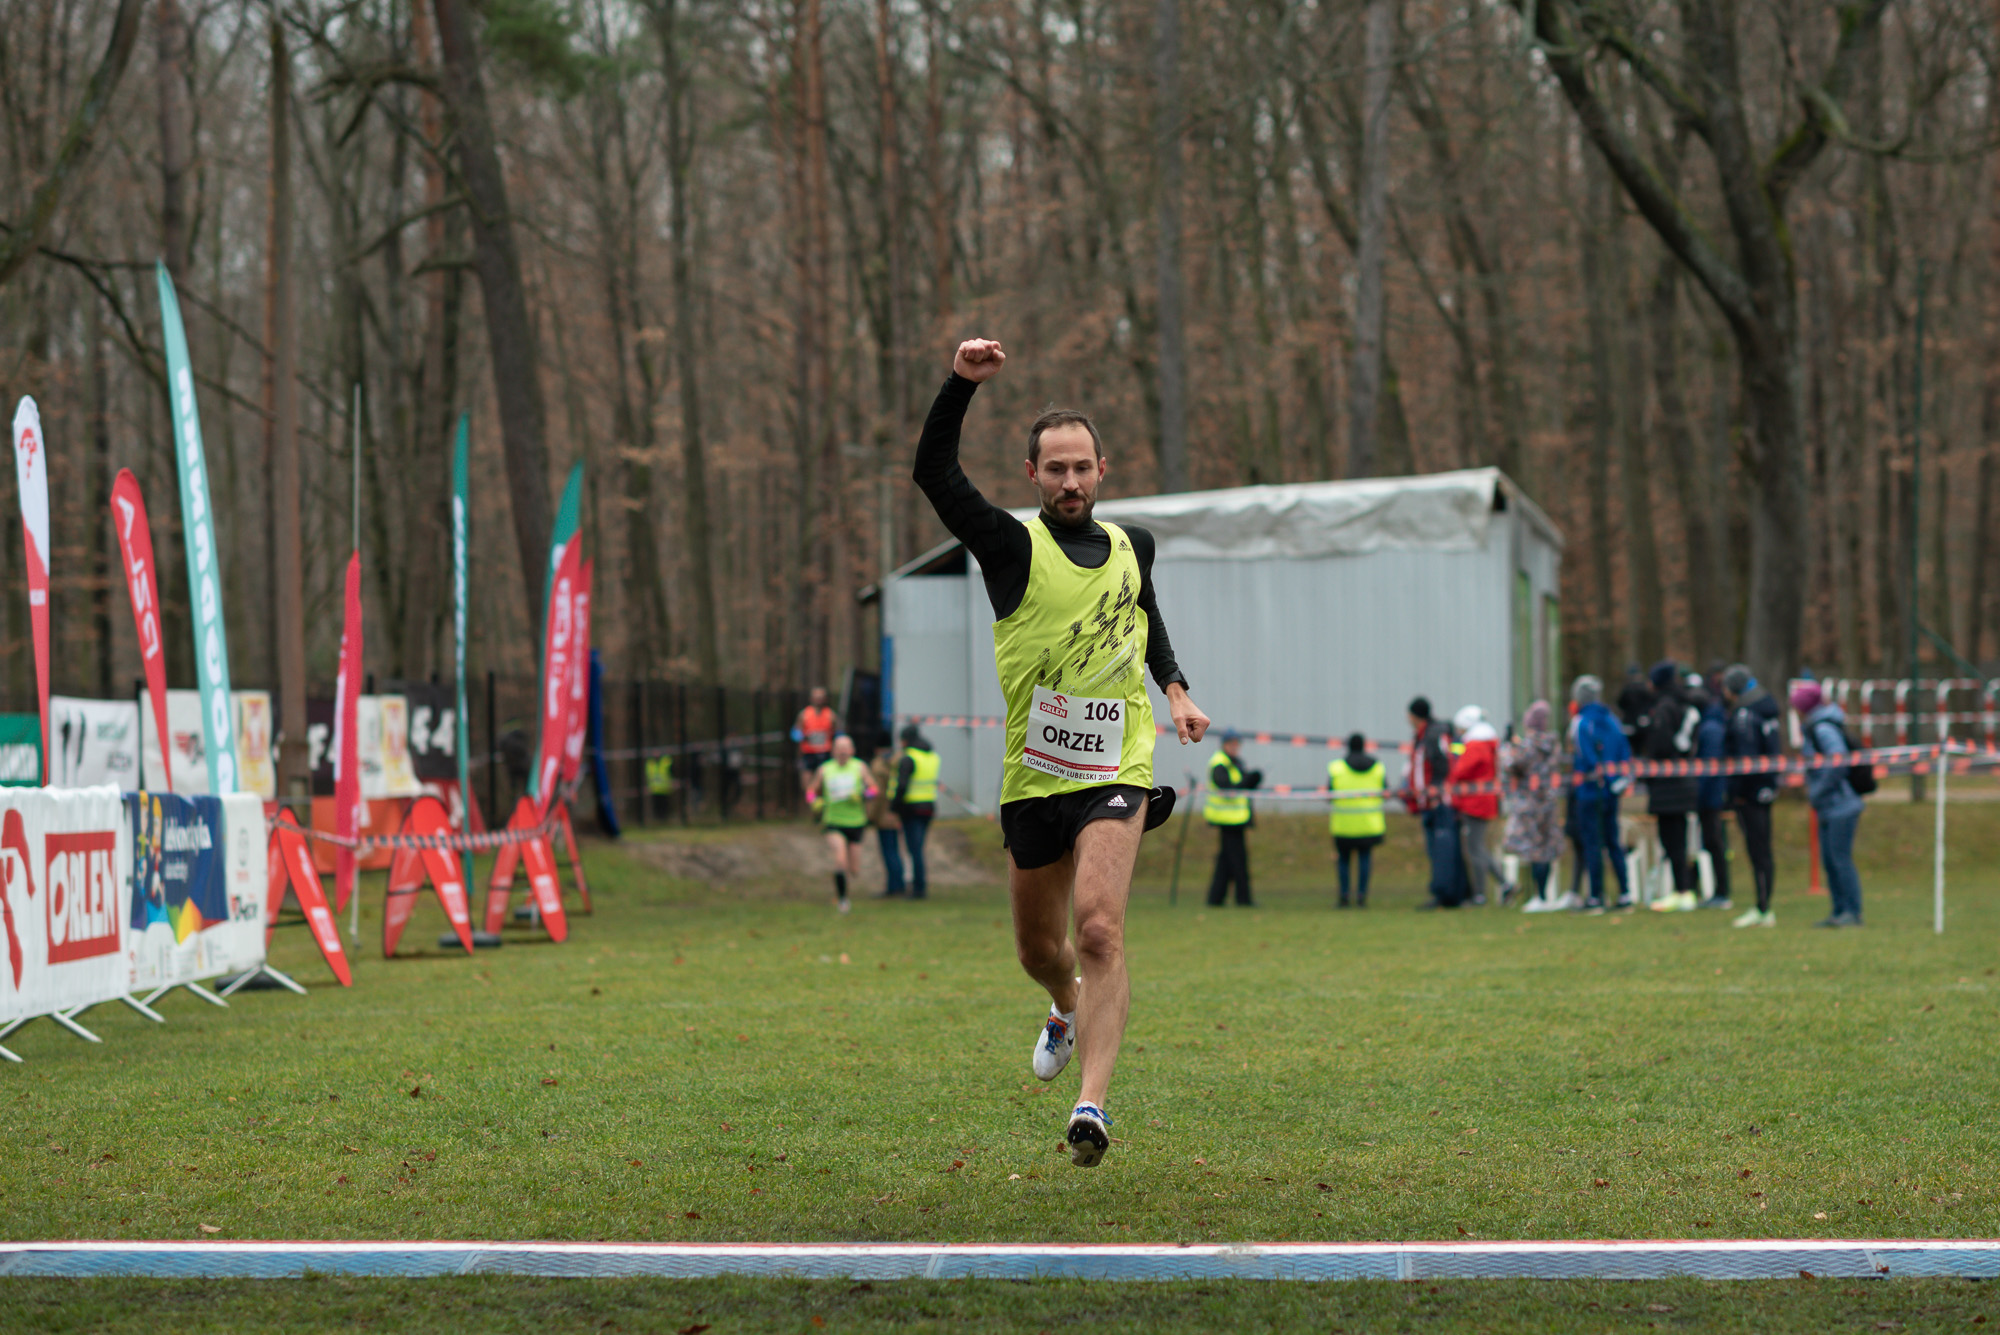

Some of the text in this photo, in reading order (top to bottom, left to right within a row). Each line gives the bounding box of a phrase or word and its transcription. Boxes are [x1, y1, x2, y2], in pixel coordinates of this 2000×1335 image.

[1041, 703, 1066, 717] ORLEN
[1084, 702, 1120, 721] 106
[1043, 725, 1104, 752] ORZEŁ
[1027, 757, 1065, 775] TOMASZÓW
[1067, 770, 1096, 780] LUBELSKI
[49, 849, 117, 947] ORLEN
